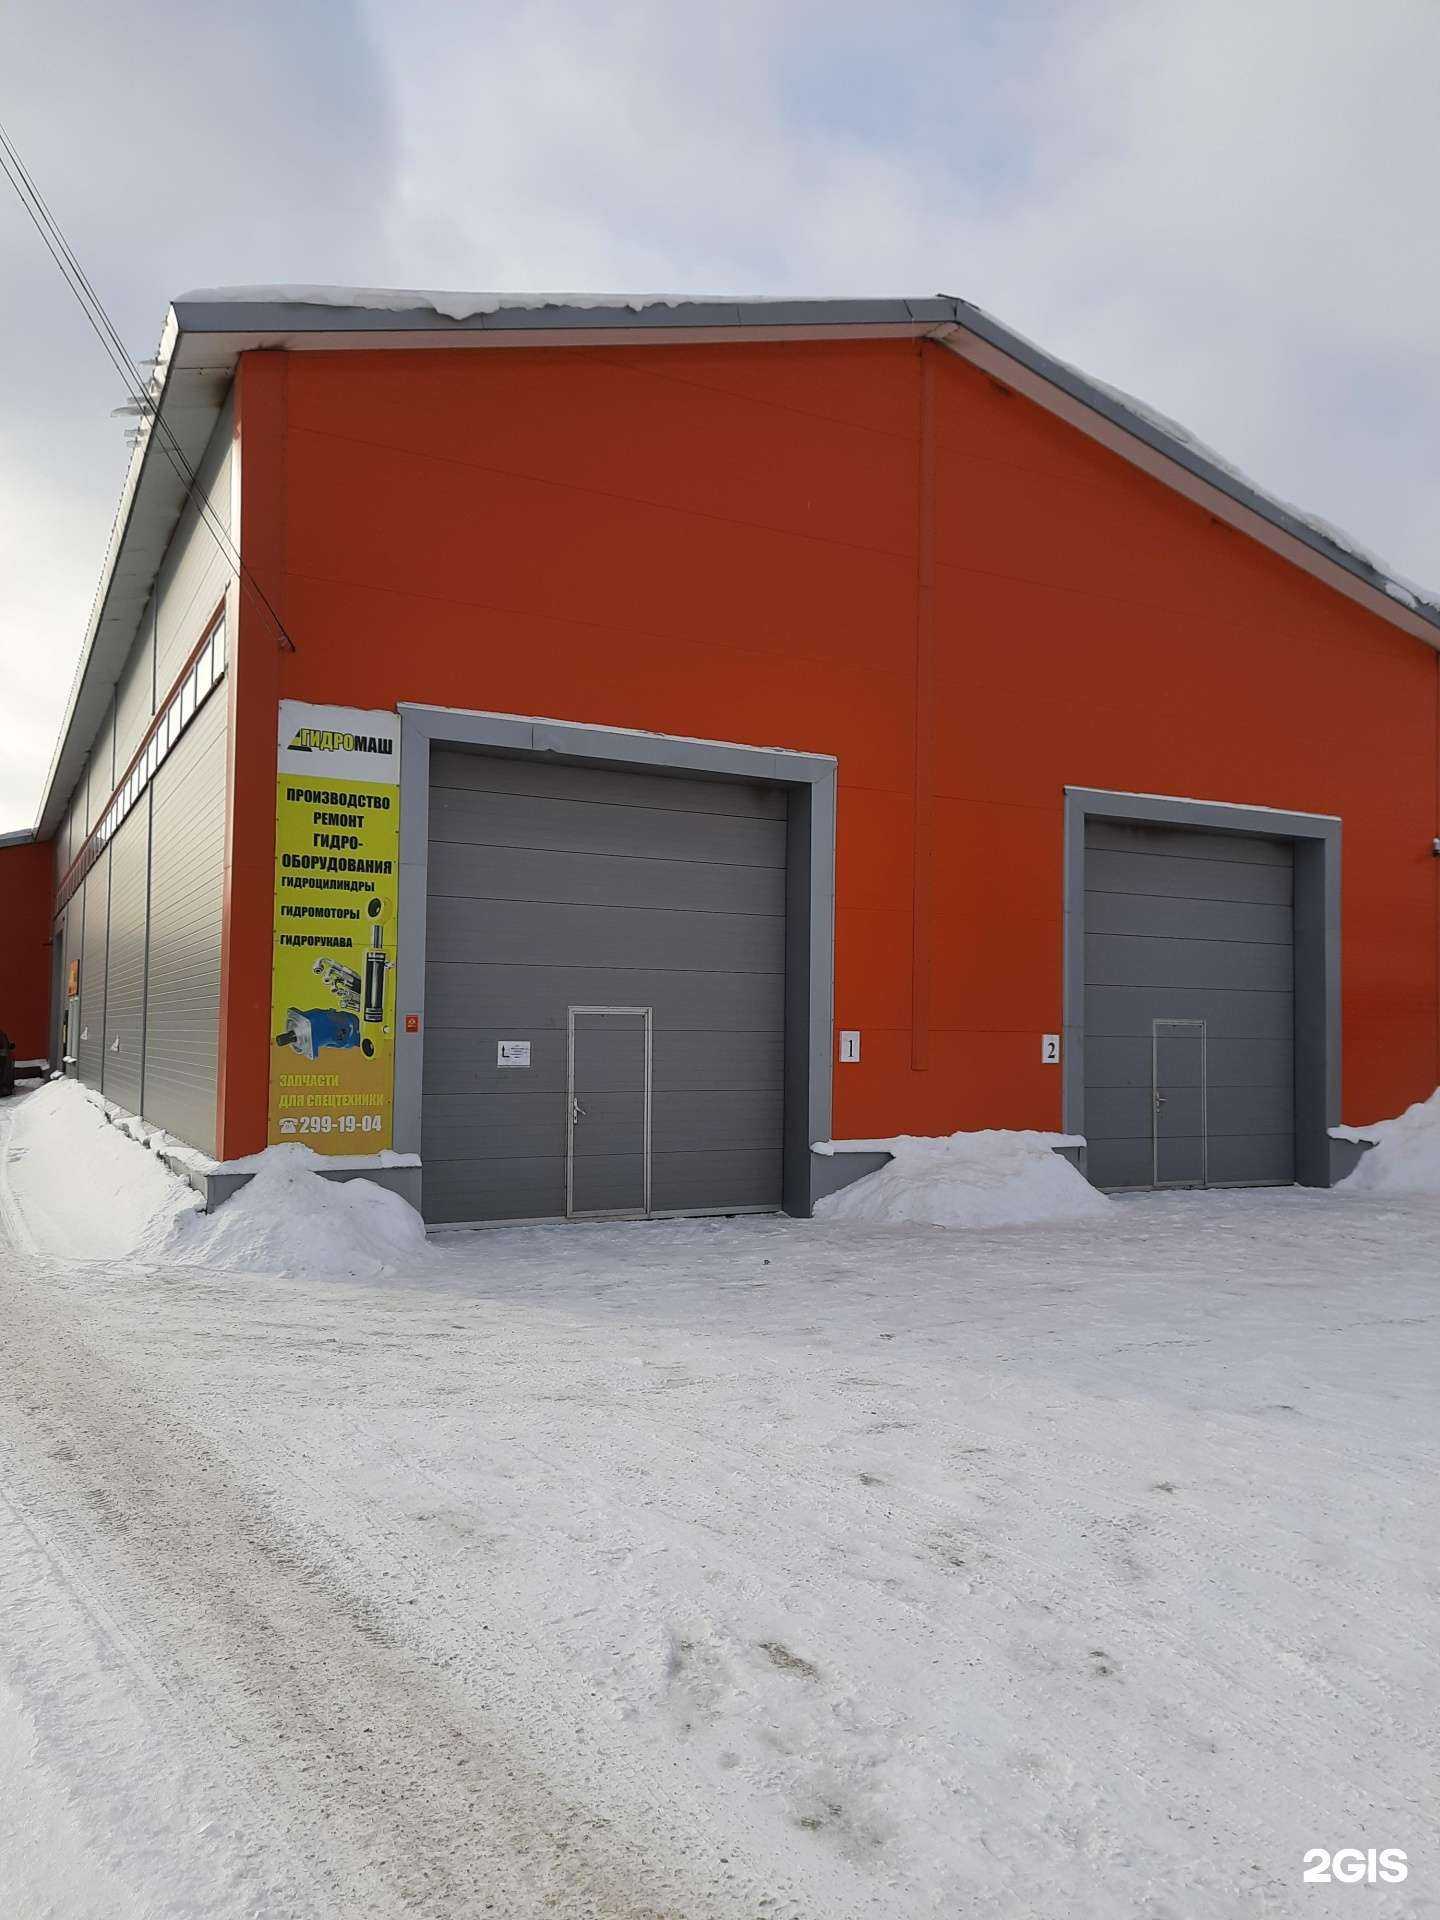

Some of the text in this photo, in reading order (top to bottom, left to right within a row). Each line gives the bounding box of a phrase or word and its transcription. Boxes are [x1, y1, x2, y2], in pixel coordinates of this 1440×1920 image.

[301, 728, 393, 755] ГИДРОМАШ
[286, 787, 391, 809] ПРОИЗВОДСТВО
[313, 811, 365, 828] РЕМОНТ
[313, 832, 364, 850] ГИДРО-
[281, 853, 392, 874] ОБОРУДОВАНИЯ
[281, 876, 375, 892] ГИДРОЦИЛИНДРЫ
[280, 905, 360, 919] ГИДРОМОТОРЫ
[279, 934, 353, 948] ГИДРОРУКАВА
[847, 1039, 854, 1057] 1
[1046, 1042, 1056, 1059] 2
[279, 1075, 340, 1087] ЗАПЧАСТИ
[278, 1093, 384, 1109] ДЛЯ СПЕЦТЕХНИКИ
[299, 1115, 383, 1133] 299-19-04
